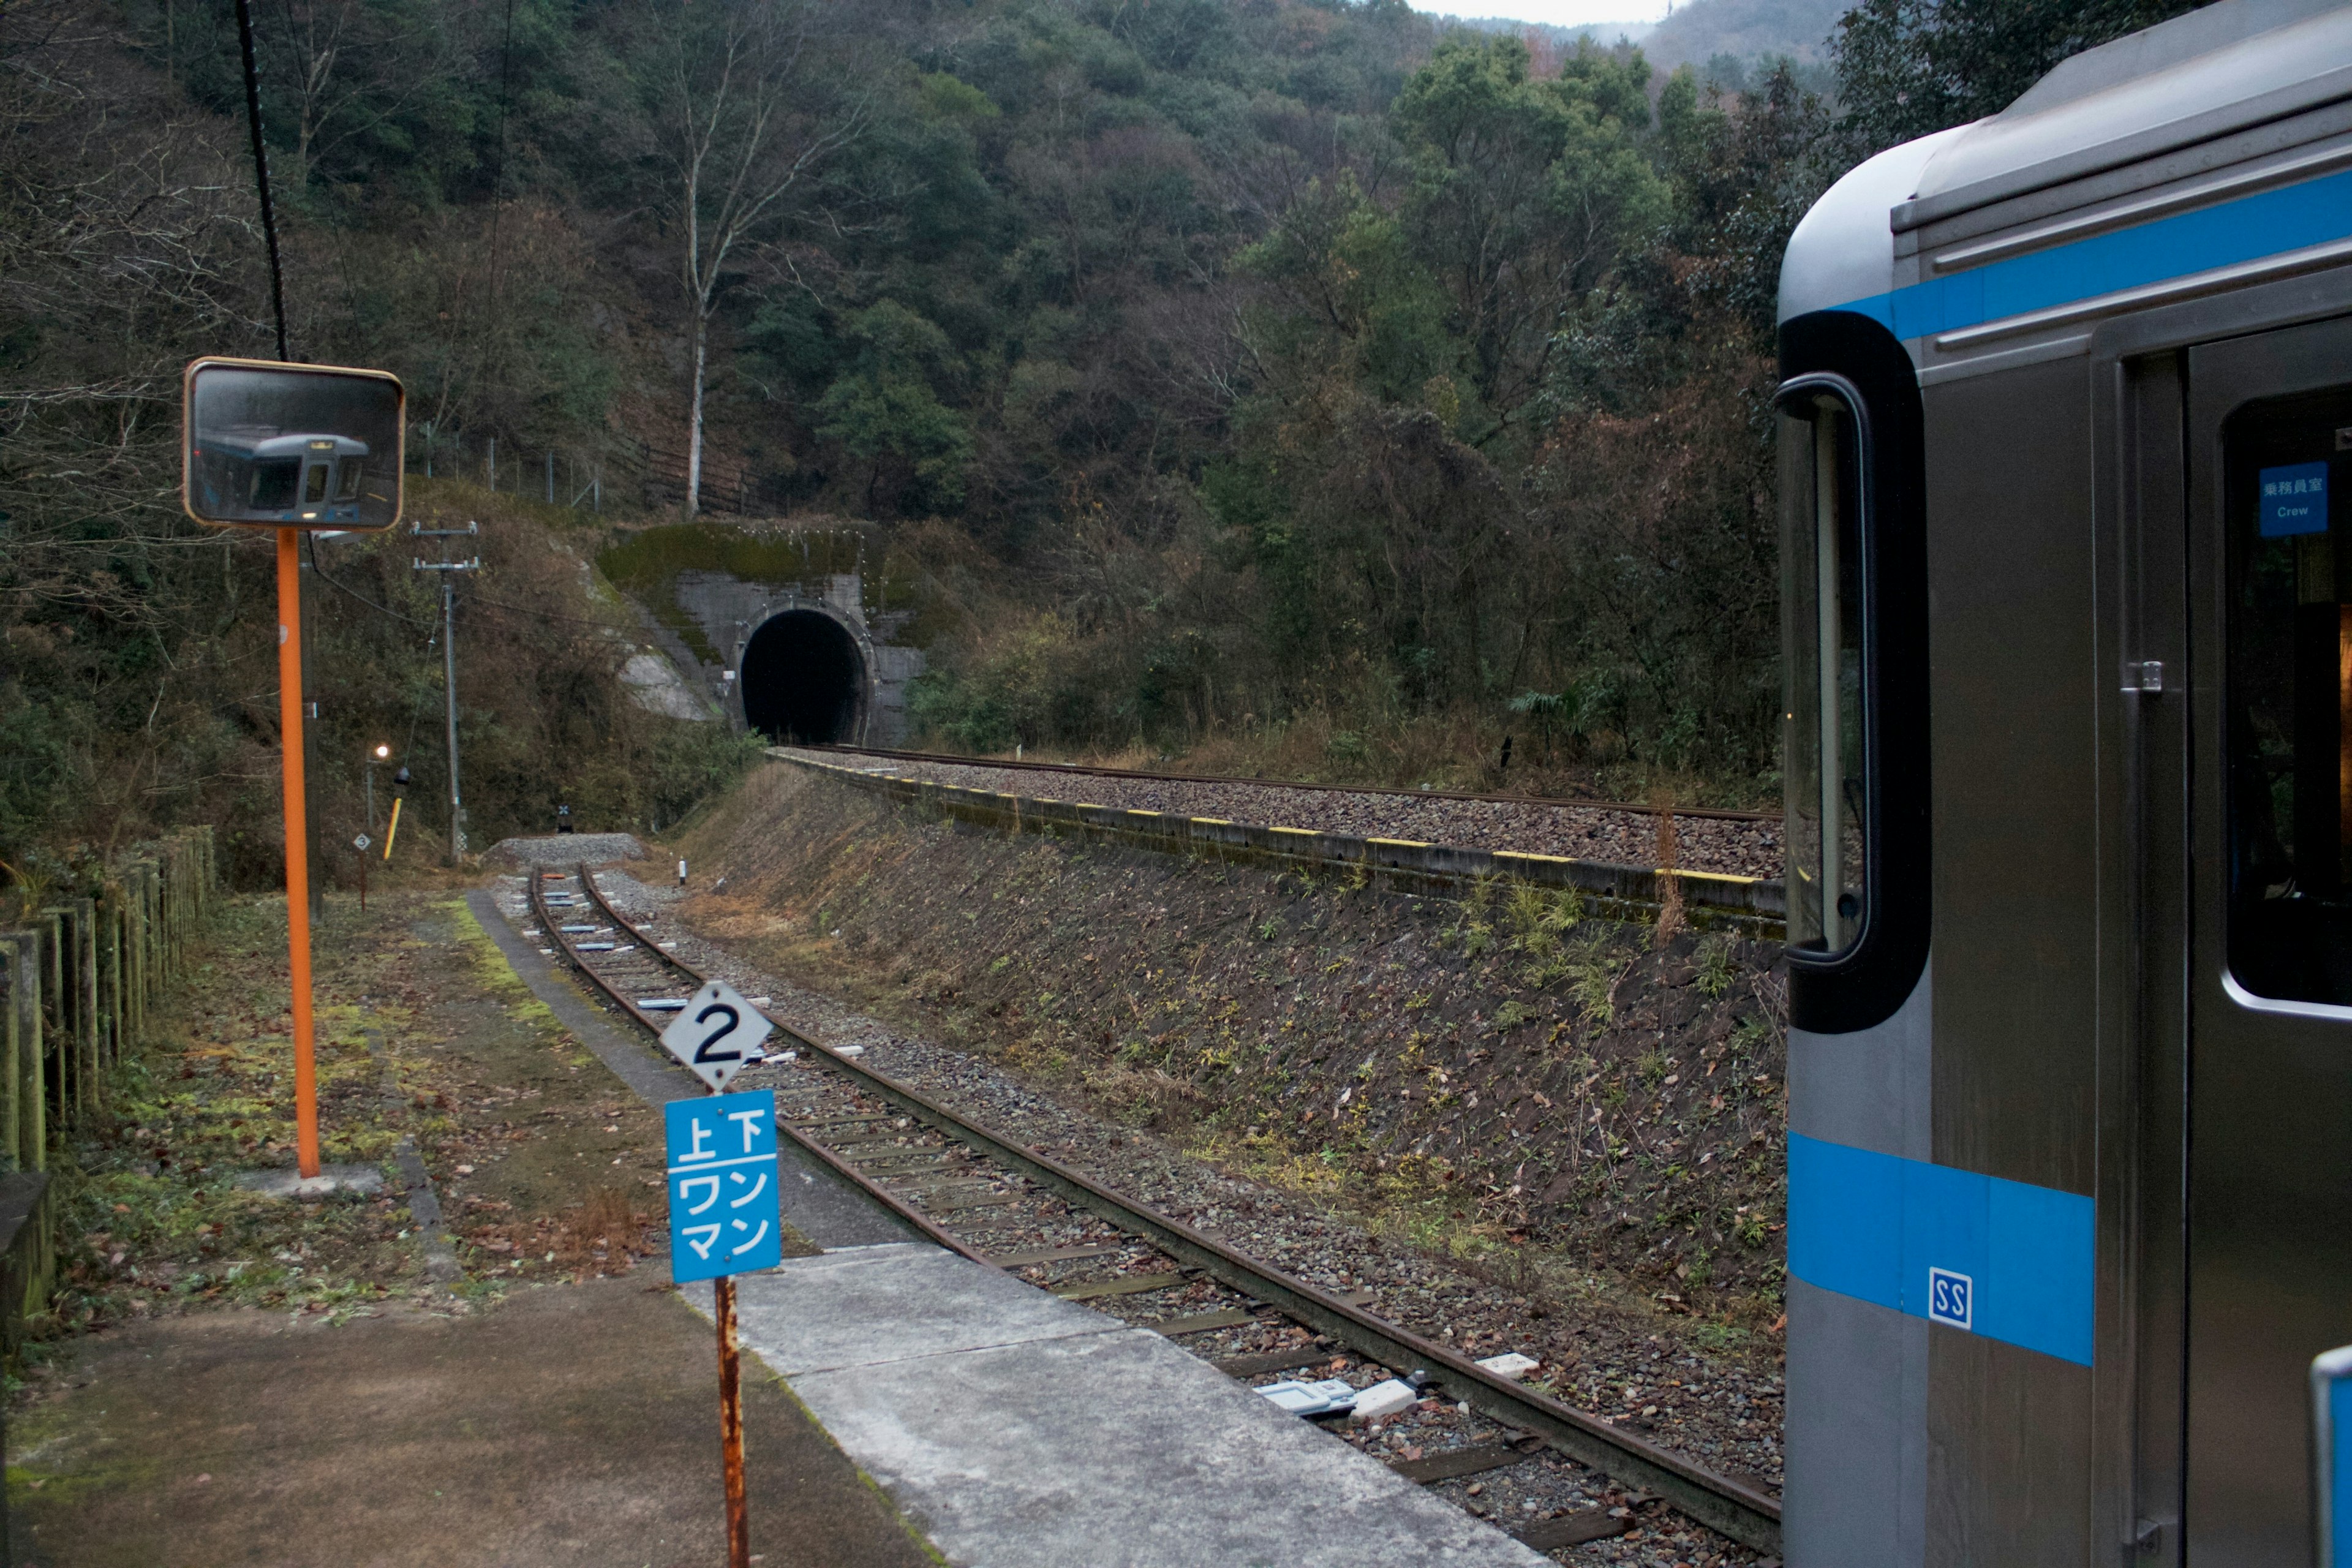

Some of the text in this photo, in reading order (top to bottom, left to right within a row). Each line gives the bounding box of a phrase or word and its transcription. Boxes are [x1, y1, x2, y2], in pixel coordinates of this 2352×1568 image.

[2264, 477, 2323, 497] 乗務員室
[2277, 507, 2309, 518] Crew
[358, 837, 366, 846] 3
[693, 1003, 742, 1065] 2
[1936, 1279, 1964, 1316] SS
